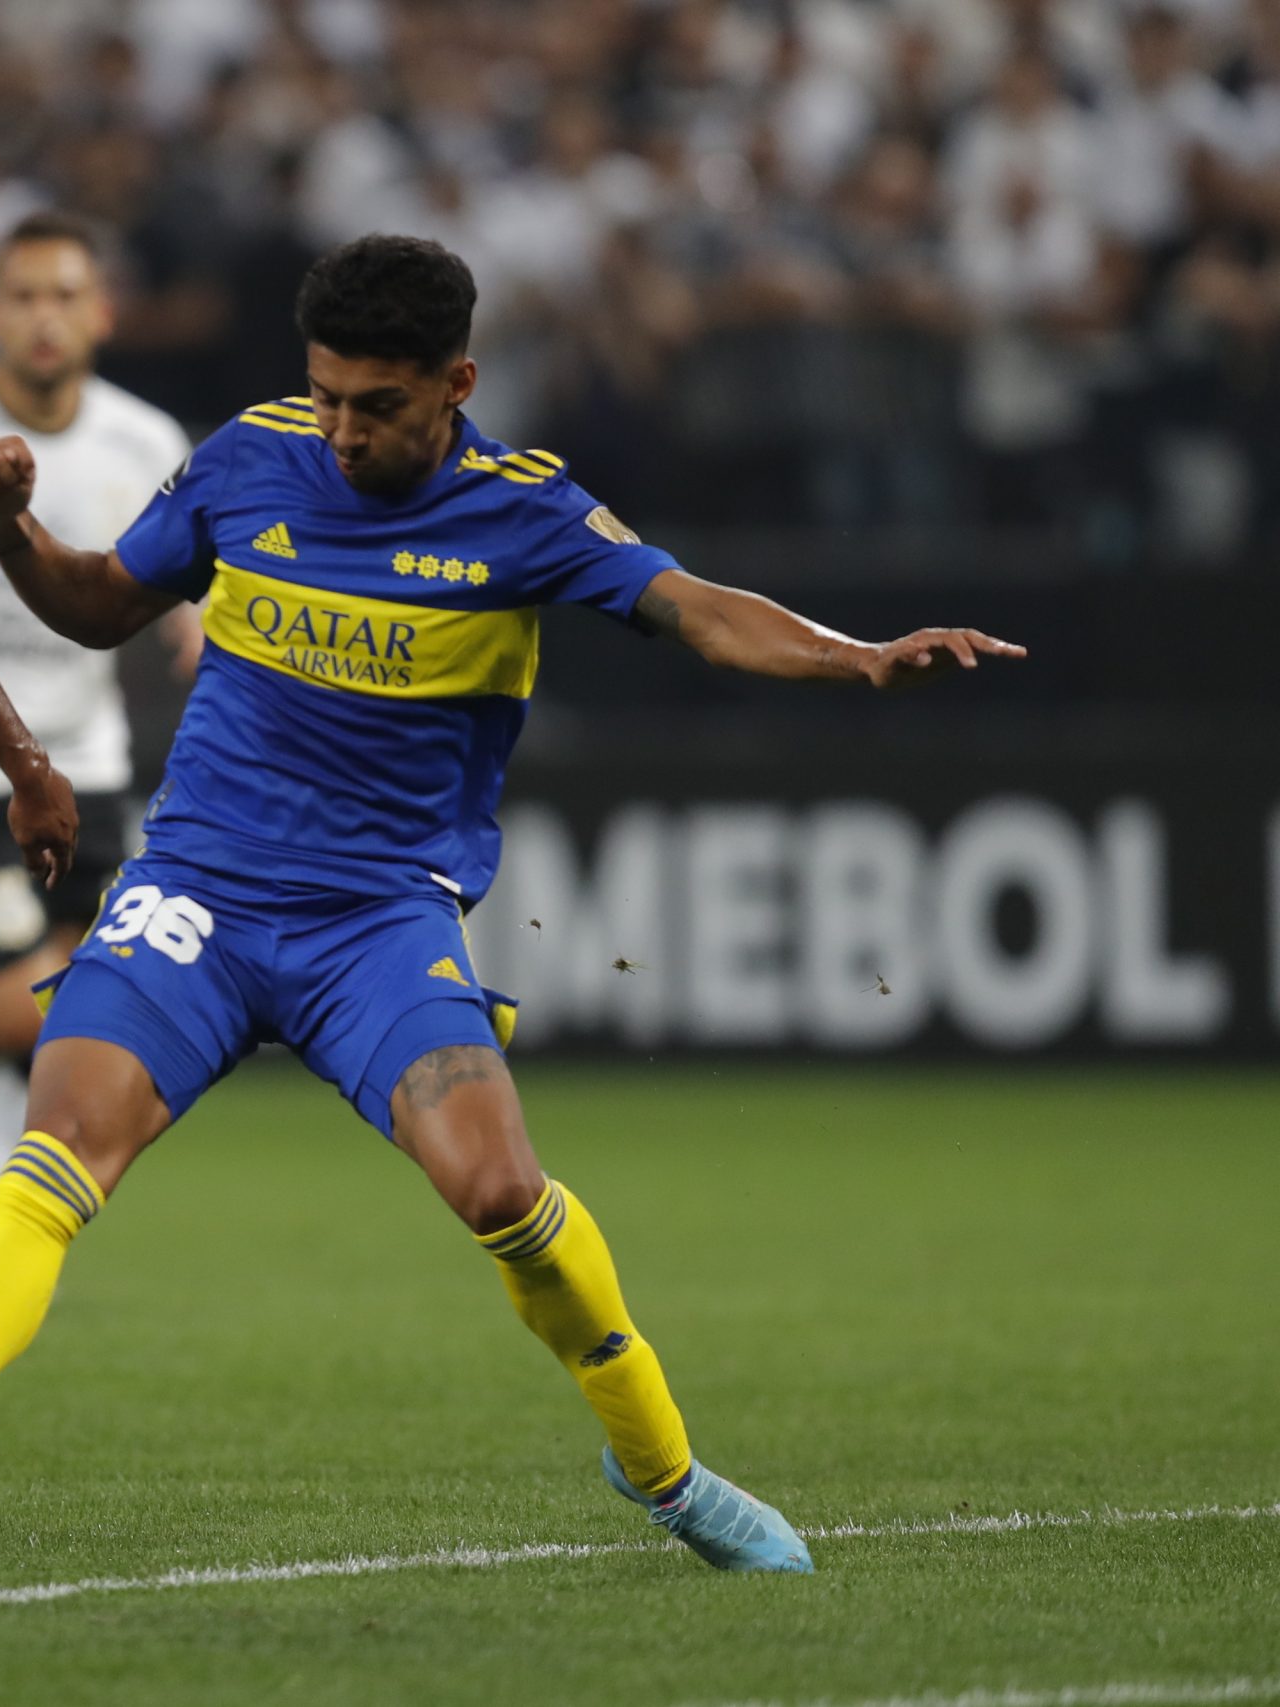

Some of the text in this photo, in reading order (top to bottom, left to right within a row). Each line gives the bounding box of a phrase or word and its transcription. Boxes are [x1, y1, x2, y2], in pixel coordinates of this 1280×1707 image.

[246, 595, 417, 663] QATAR
[281, 646, 413, 688] AIRWAYS
[96, 885, 214, 965] 36
